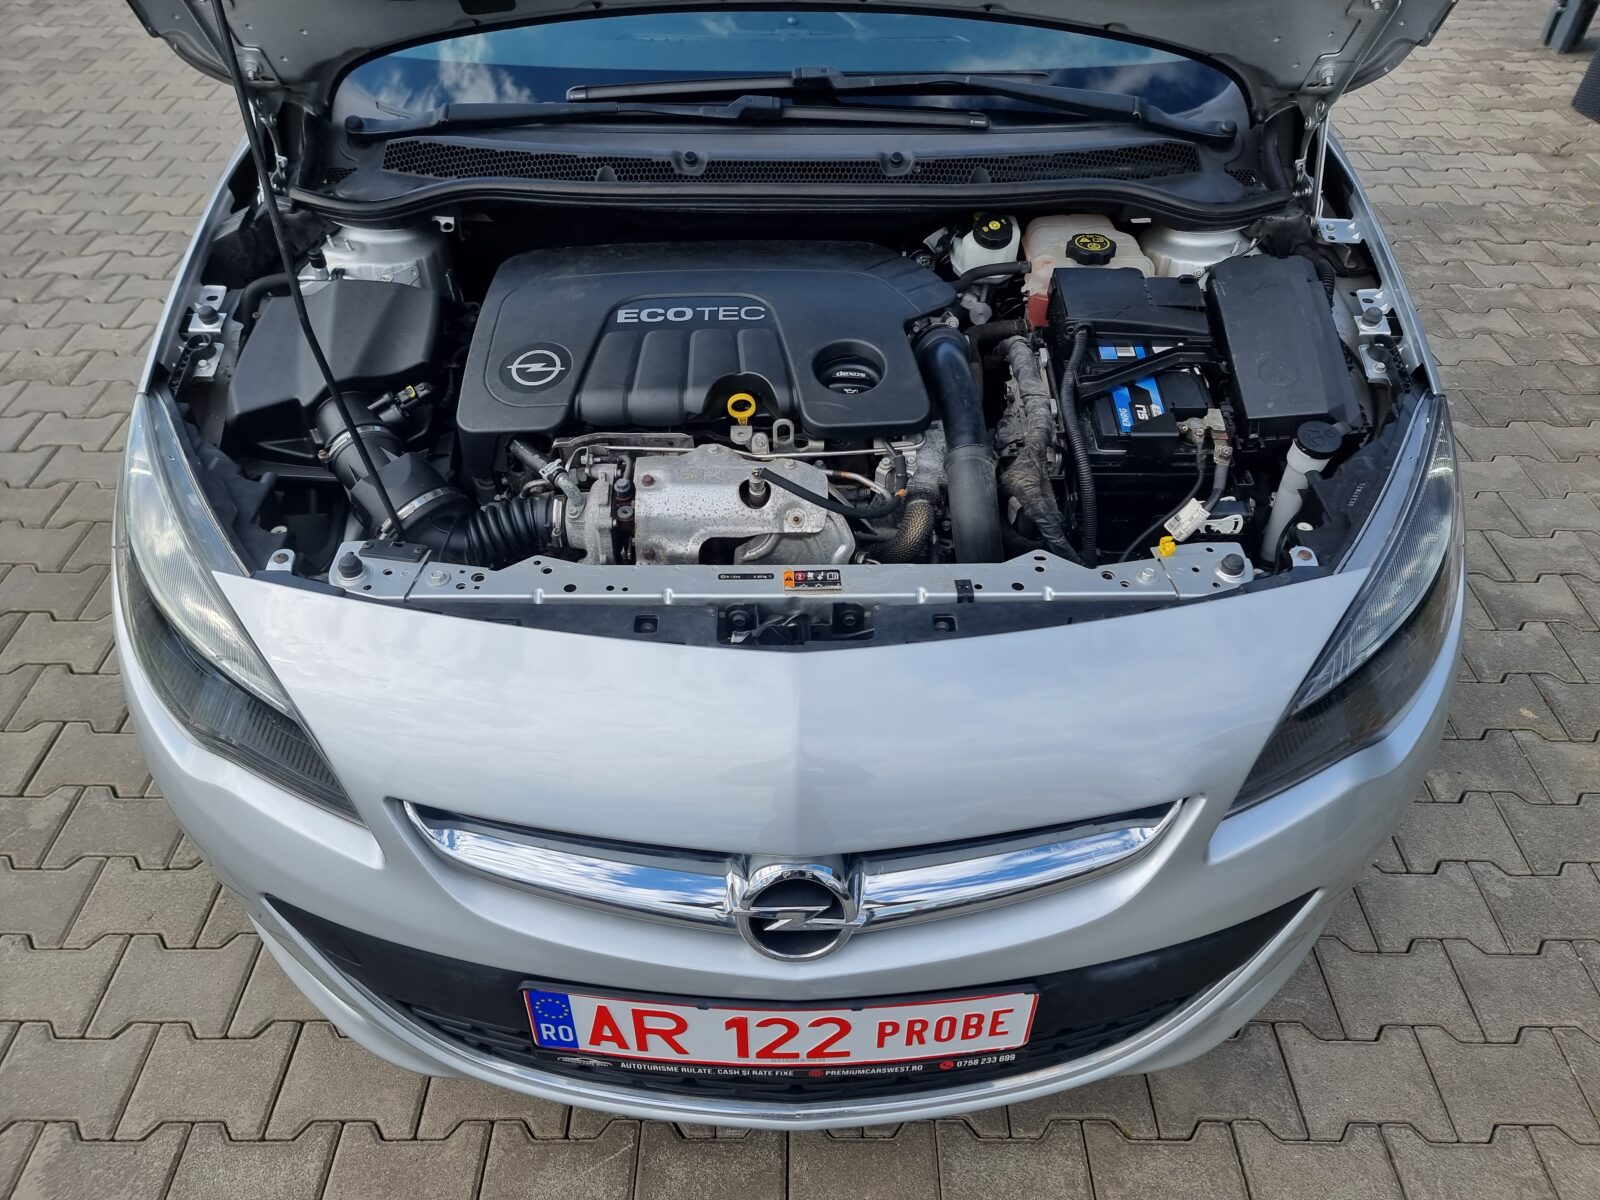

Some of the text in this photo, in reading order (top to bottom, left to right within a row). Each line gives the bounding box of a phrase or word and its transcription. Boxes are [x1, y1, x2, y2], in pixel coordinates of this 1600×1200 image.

[616, 306, 766, 323] ECOTEC
[540, 1023, 574, 1042] RO
[588, 1005, 1014, 1059] AR 122 PROBE
[620, 1062, 680, 1073] AUTOTURISME
[956, 1059, 978, 1067] 0758
[980, 1056, 998, 1064] 233
[825, 1065, 923, 1076] PREMIUMCARSWEST.RO
